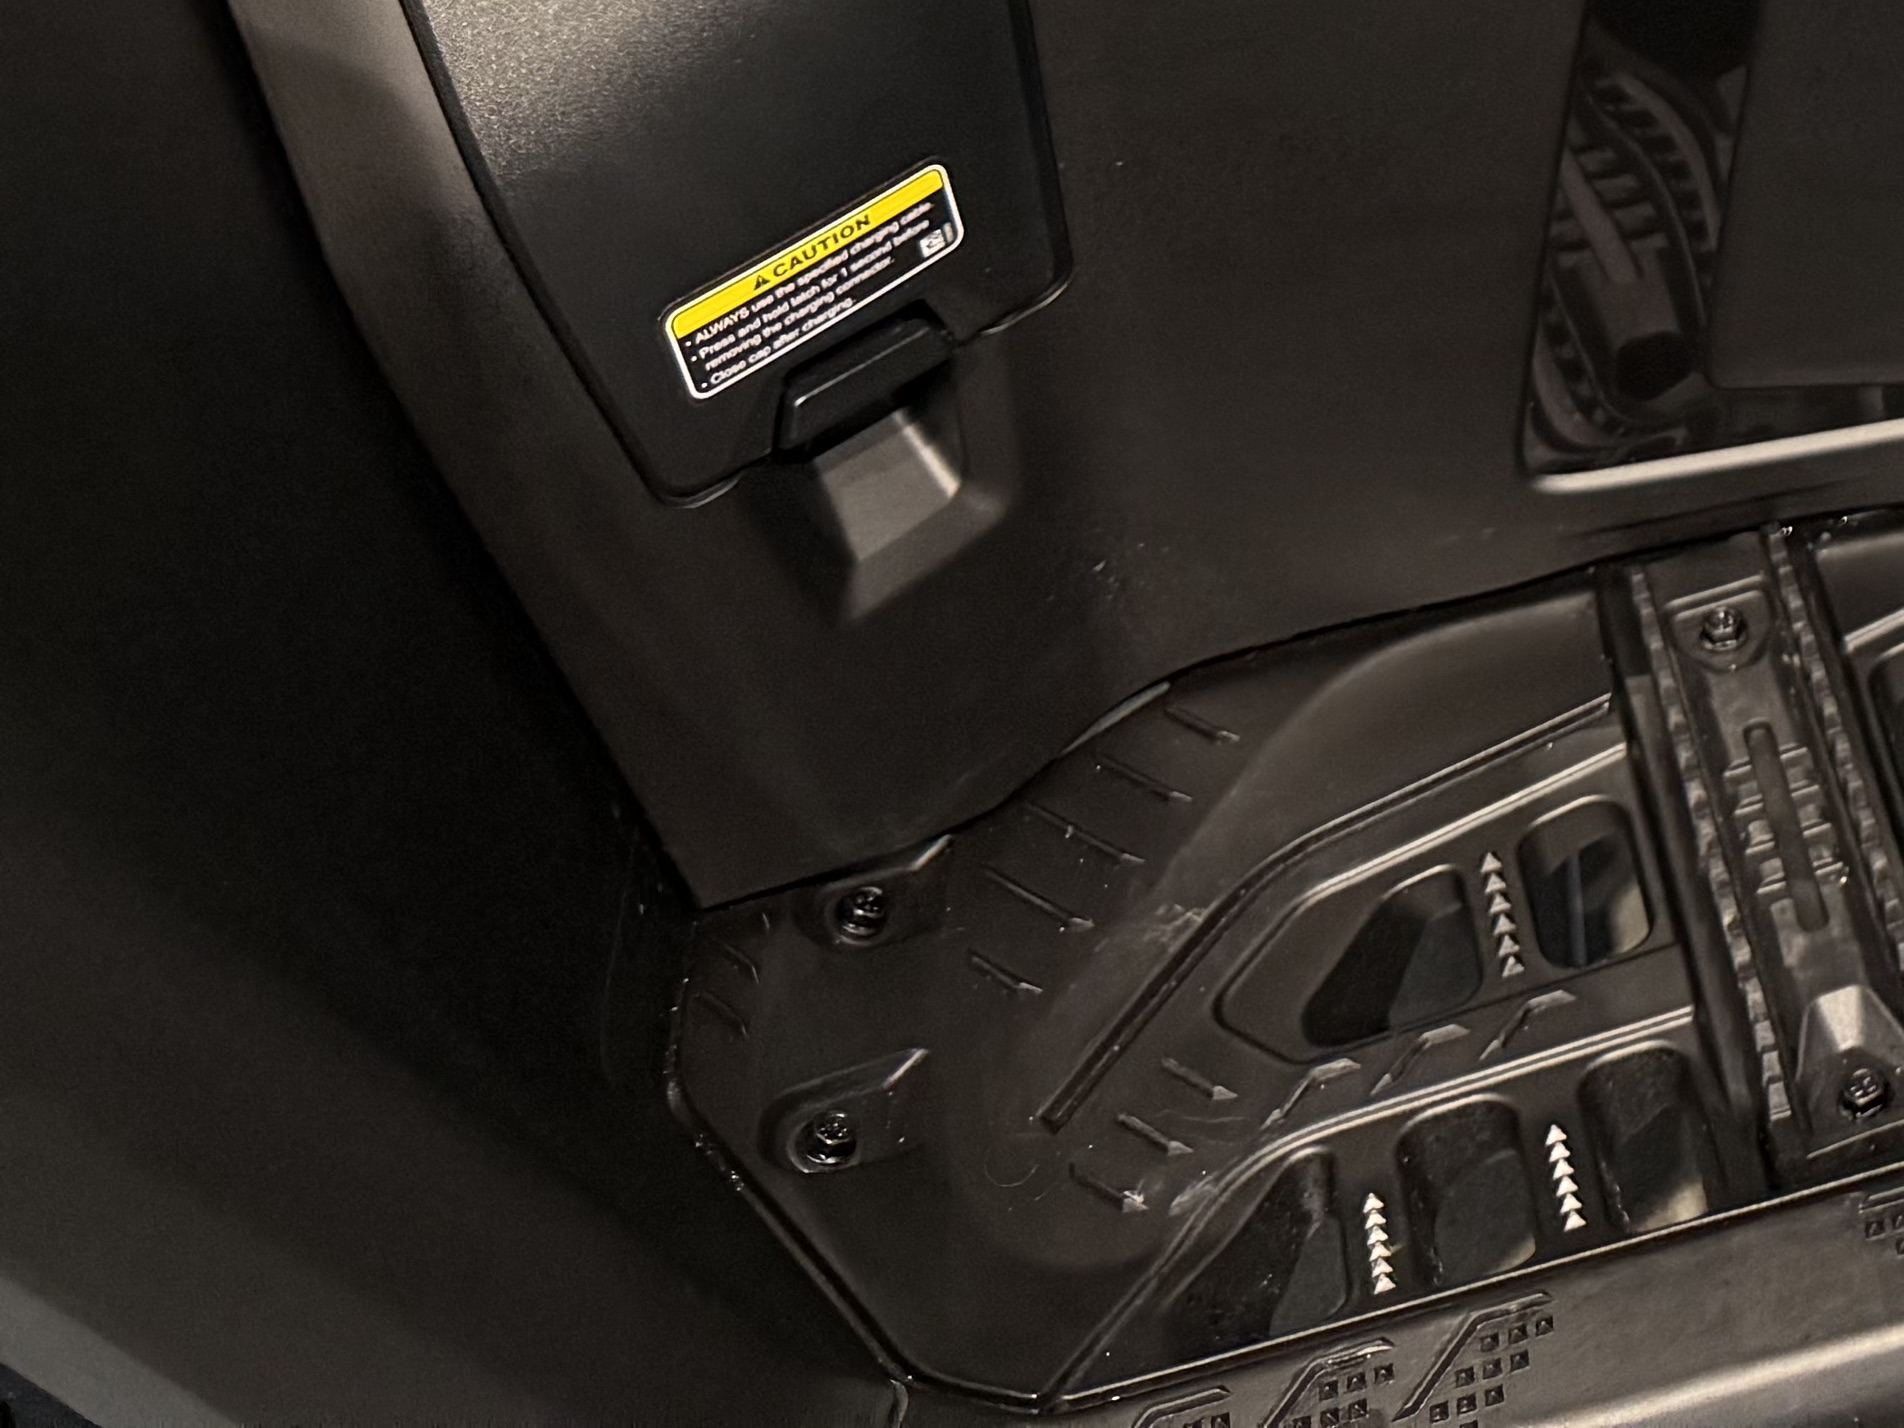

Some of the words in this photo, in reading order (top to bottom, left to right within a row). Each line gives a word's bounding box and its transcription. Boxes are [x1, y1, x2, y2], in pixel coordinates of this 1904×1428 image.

[695, 307, 749, 344] ALWAYS
[751, 295, 774, 312] use
[775, 283, 795, 298] the
[797, 250, 848, 286] specified
[850, 222, 899, 255] charging
[773, 214, 870, 276] CAUTION
[699, 334, 735, 359] Press
[738, 317, 761, 337] and
[762, 302, 789, 323] hold
[790, 286, 820, 307] latch
[821, 274, 837, 289] for
[850, 241, 892, 272] second
[892, 220, 929, 246] before
[705, 334, 762, 370] removing
[762, 322, 782, 338] the
[784, 292, 835, 325] charging
[710, 360, 746, 384] Close
[748, 346, 771, 363] cap
[773, 328, 799, 349] after
